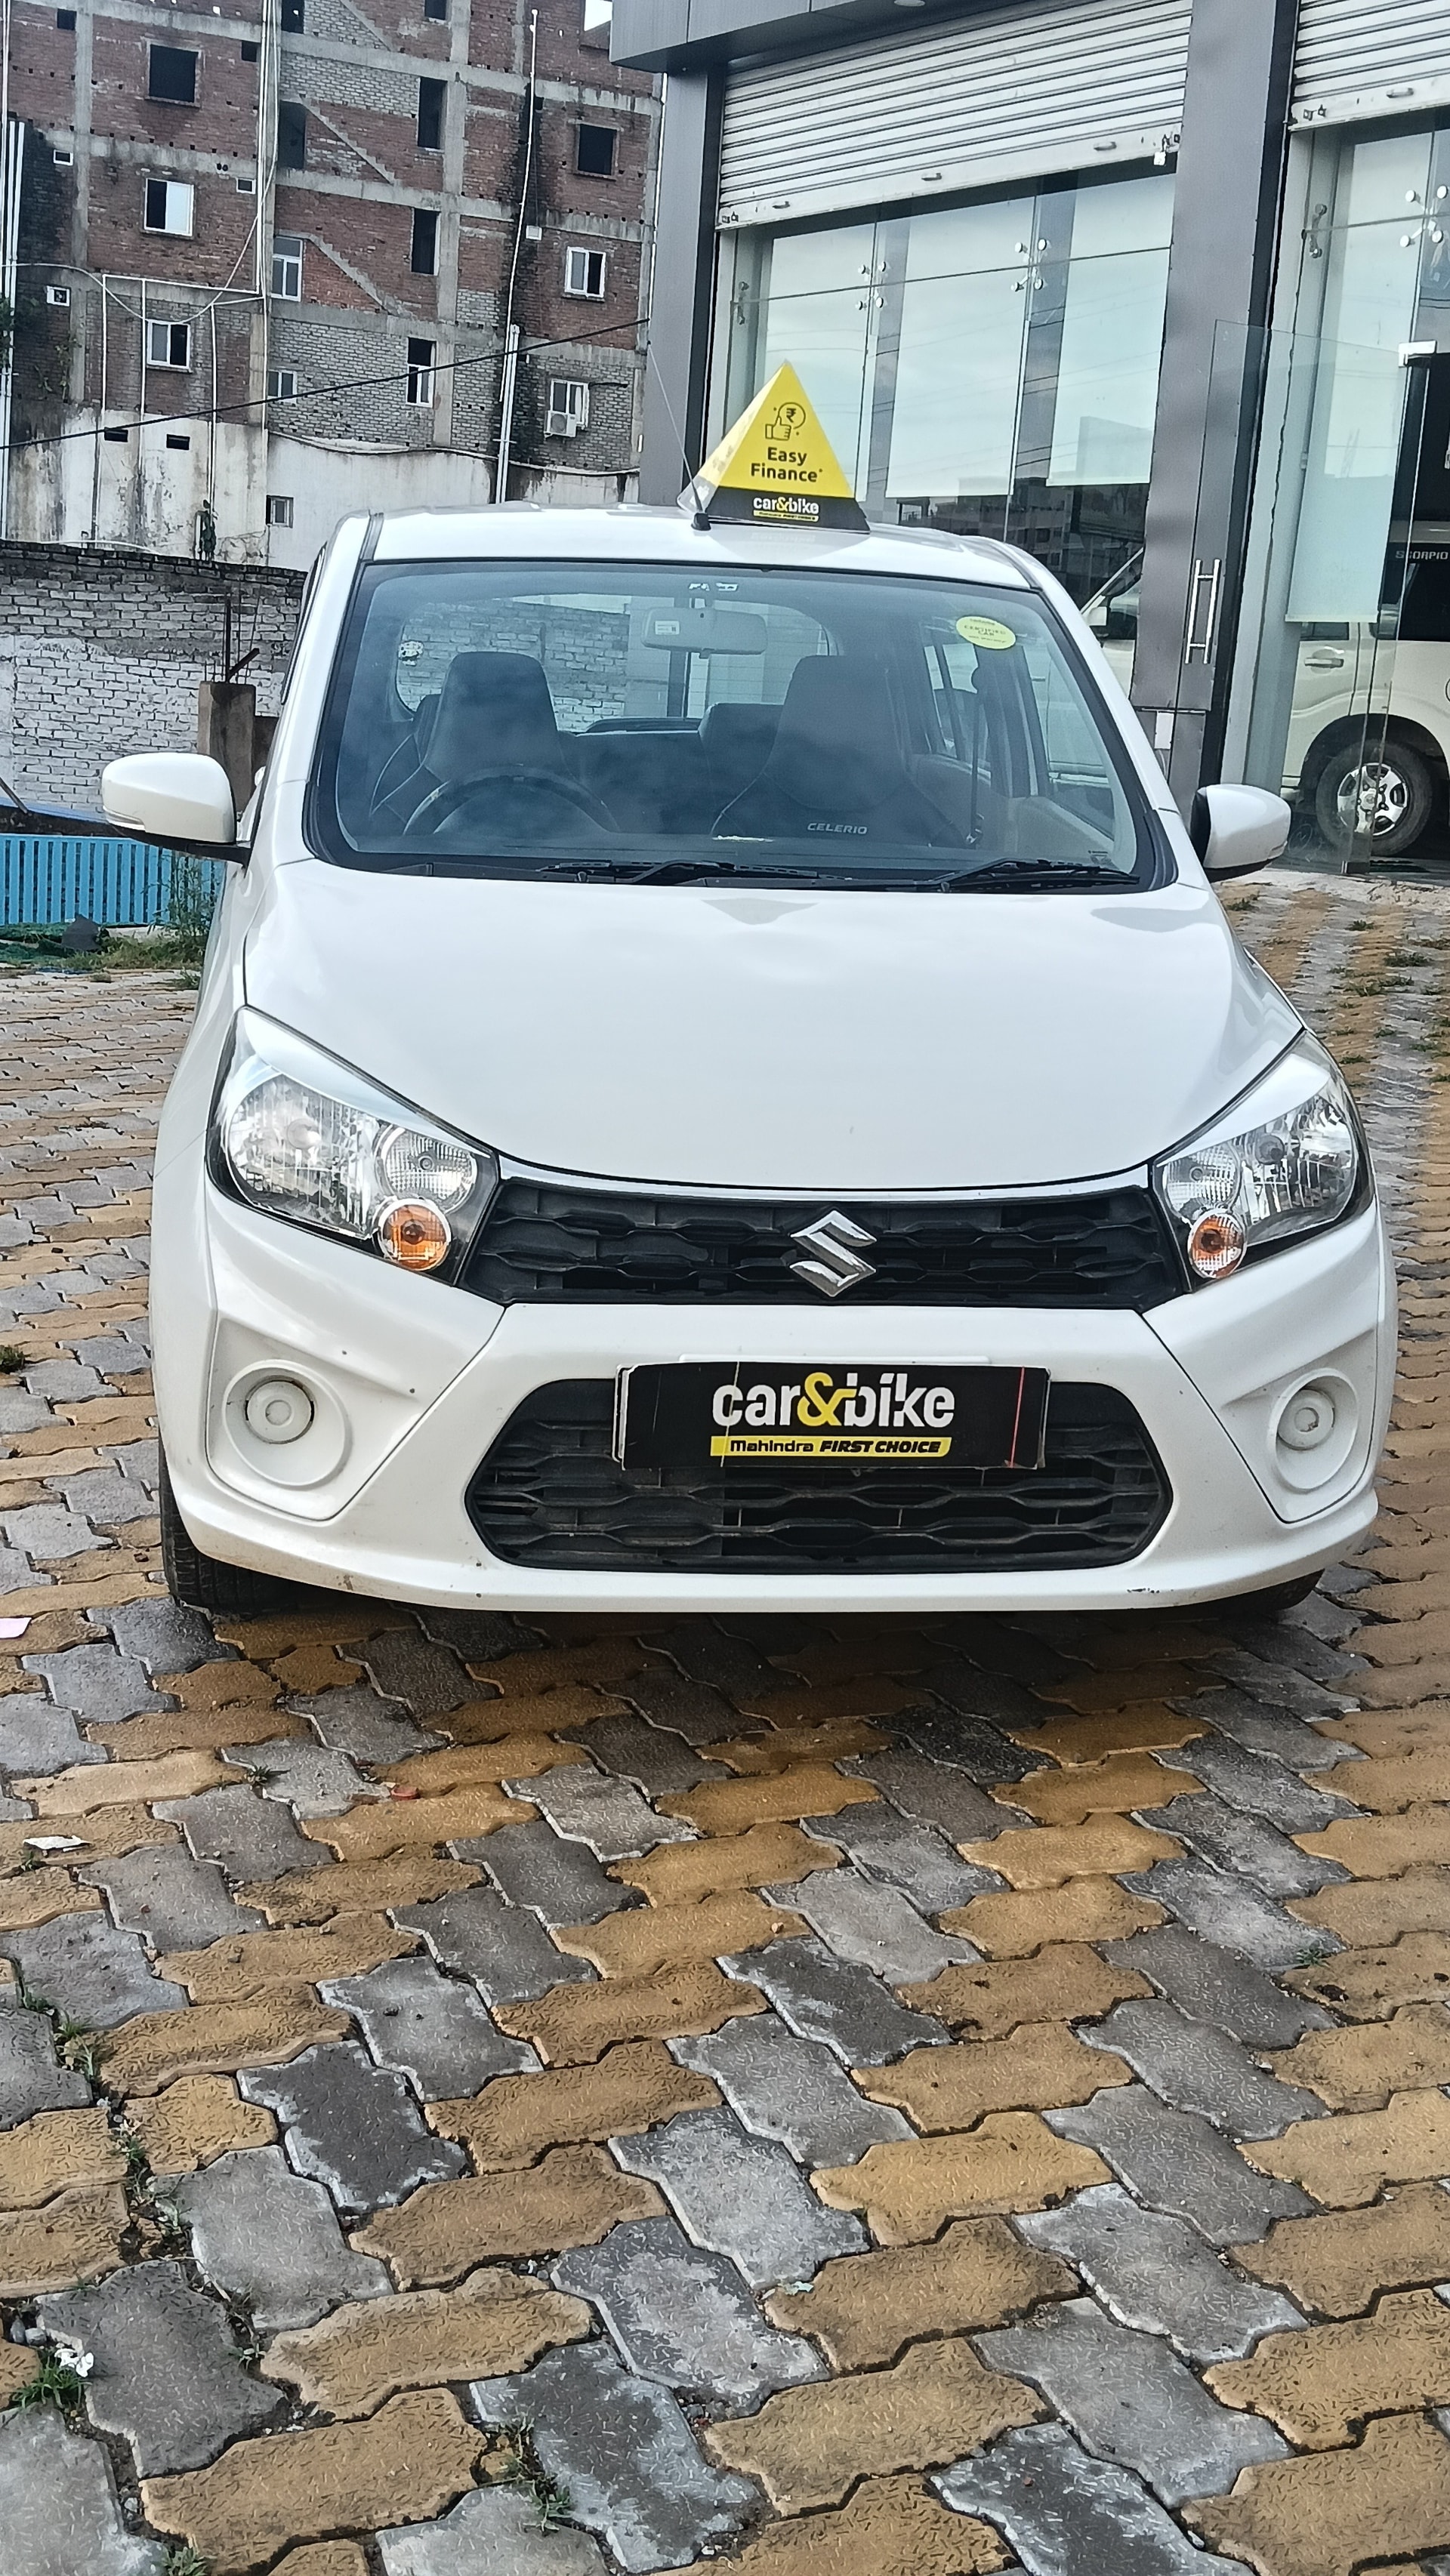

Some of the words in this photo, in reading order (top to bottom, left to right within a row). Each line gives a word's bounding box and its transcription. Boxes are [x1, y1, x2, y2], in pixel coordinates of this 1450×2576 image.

[767, 446, 807, 466] Easy
[753, 497, 819, 514] car&bike
[807, 823, 868, 834] CELERIO
[712, 1372, 955, 1427] car&bike
[730, 1440, 814, 1453] Mahindra
[819, 1441, 875, 1453] FIRST
[875, 1441, 942, 1453] CHOICE
